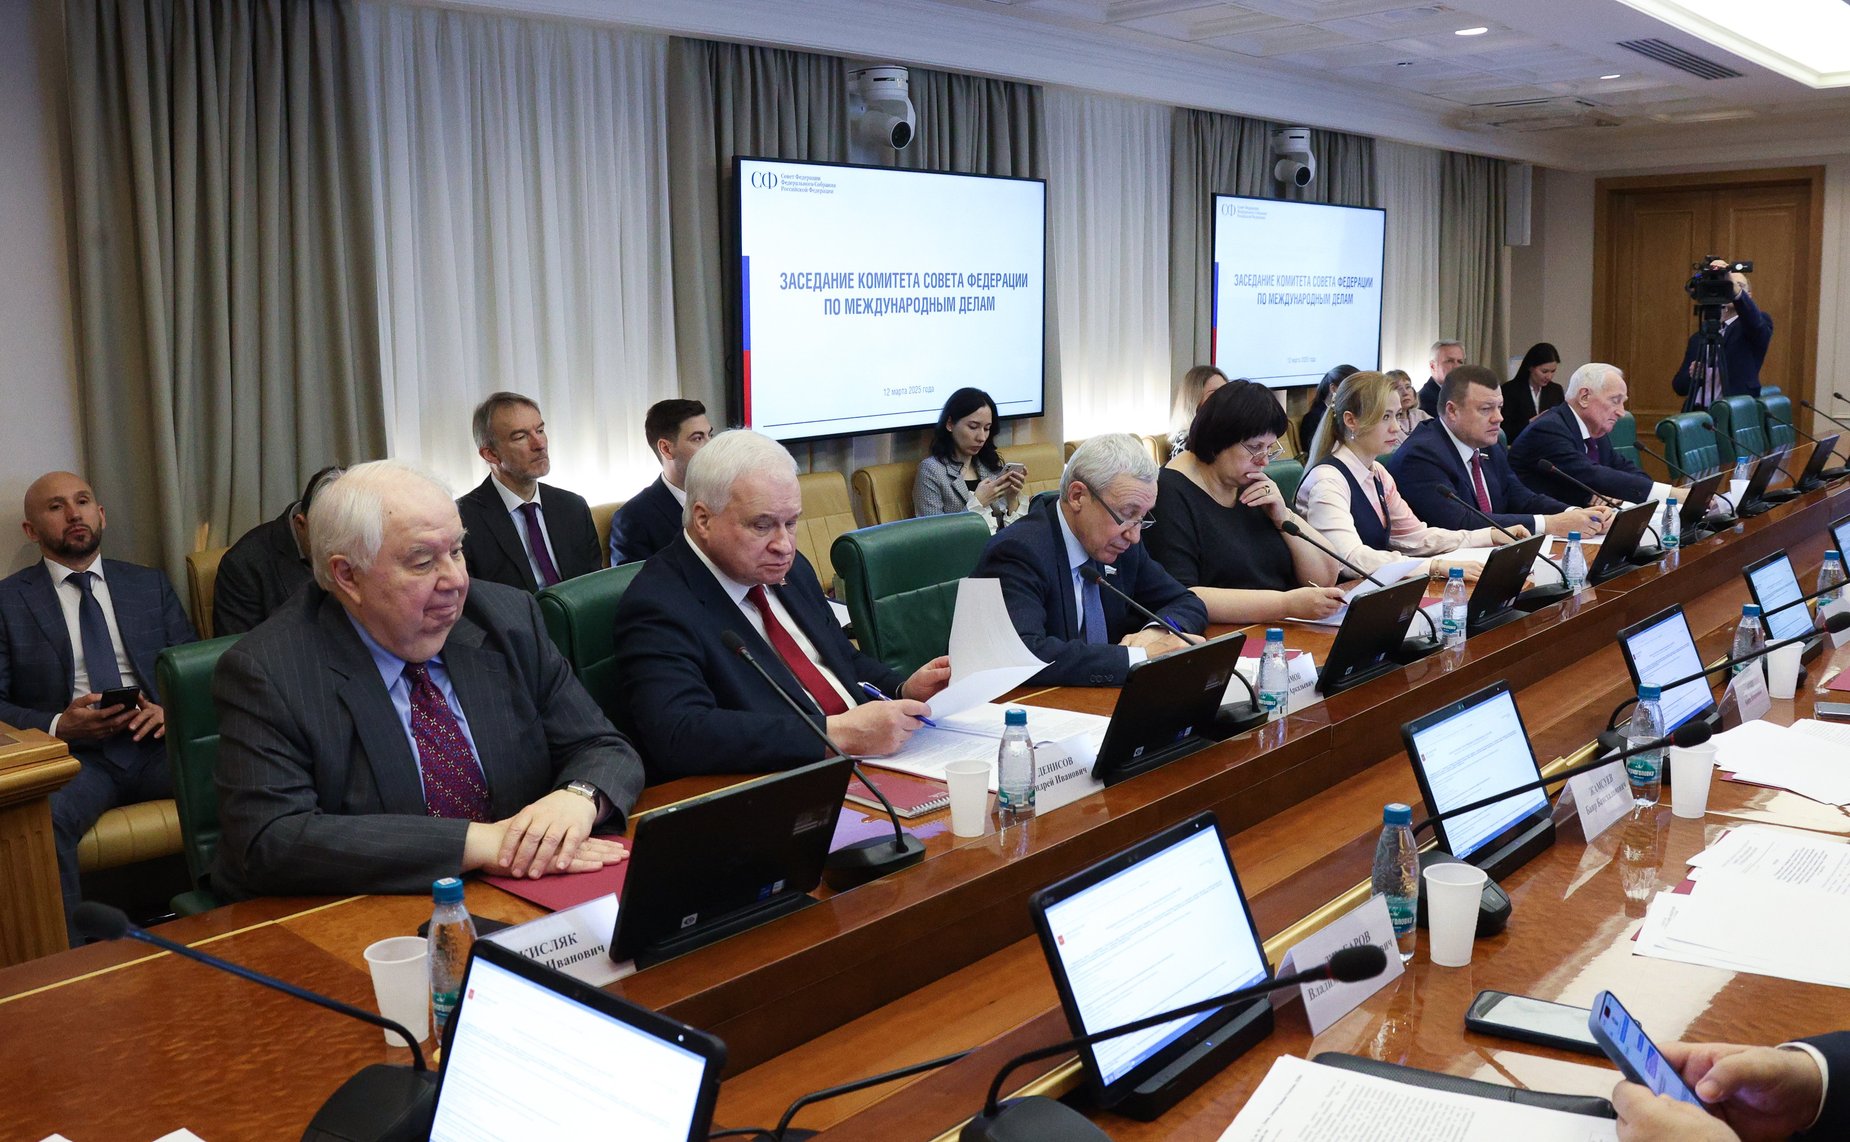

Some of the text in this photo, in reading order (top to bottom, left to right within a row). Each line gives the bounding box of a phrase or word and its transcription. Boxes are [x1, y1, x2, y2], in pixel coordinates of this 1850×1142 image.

[751, 171, 778, 190] СФ
[779, 272, 1029, 292] ЗАСЕДАНИЕ КОМИТЕТА СОВЕТА ФЕДЕРАЦИИ
[1234, 274, 1374, 289] ЗАСЕДАНИЕ КОМИТЕТА СОВЕТА ФЕДЕРАЦИИ
[824, 296, 995, 317] ПО МЕЖДУНАРОДНЫМ ДЕЛАМ
[1257, 292, 1354, 307] ПО МЕЖДУНАРОДНЫМ ДЕЛАМ
[883, 387, 890, 397] 12
[1038, 756, 1074, 778] ДЕНИСОВ
[1032, 767, 1088, 793] ндрей Иванович
[519, 932, 578, 959] КИСЛЯК
[546, 944, 605, 970] Иванович
